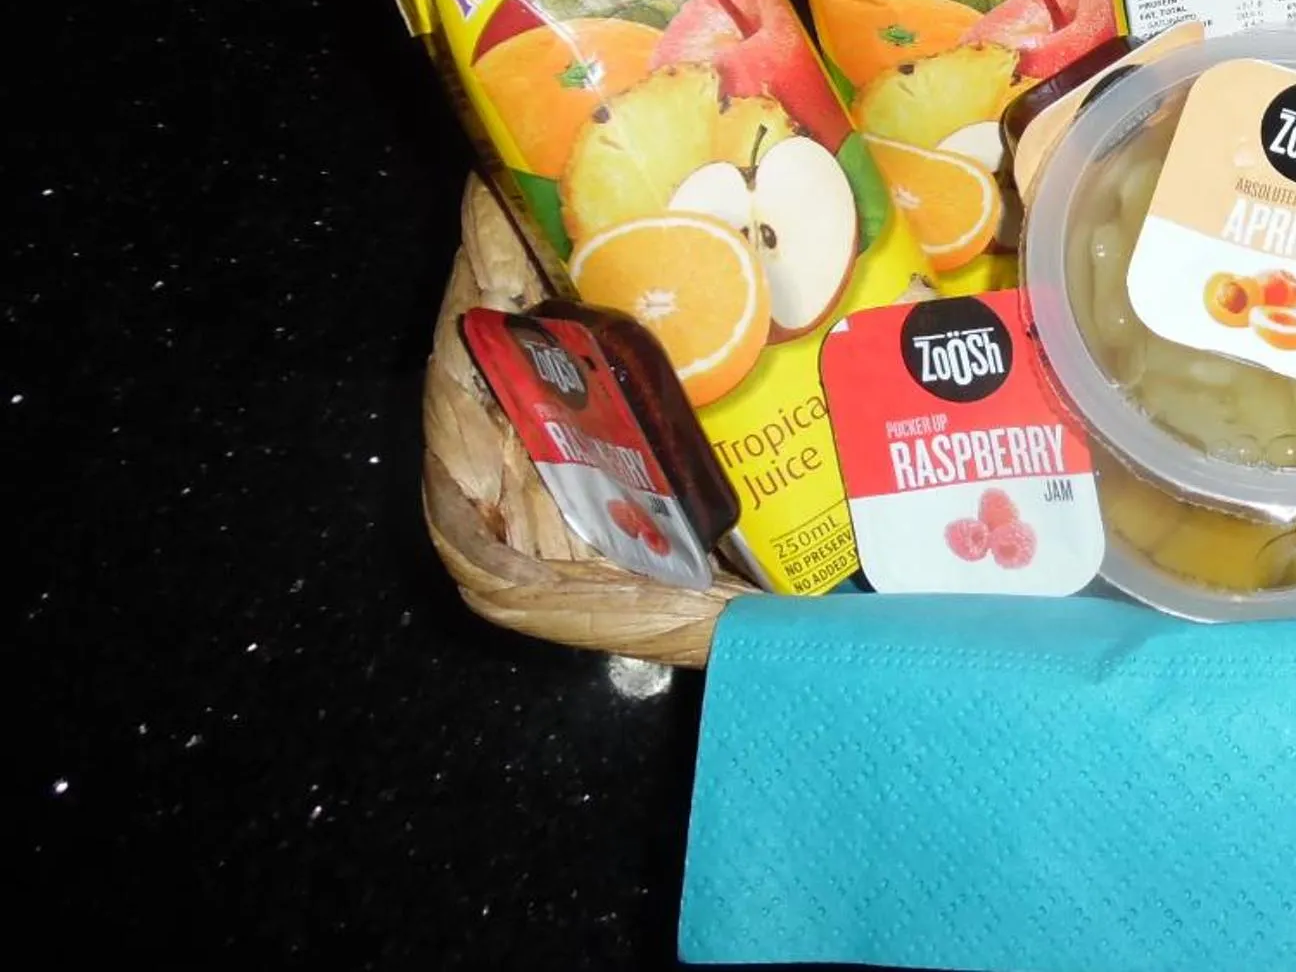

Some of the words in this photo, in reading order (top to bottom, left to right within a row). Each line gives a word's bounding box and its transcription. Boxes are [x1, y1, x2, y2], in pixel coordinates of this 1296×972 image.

[713, 395, 829, 468] Tropica
[889, 424, 1064, 489] RASPBERRY
[743, 445, 822, 510] Juice
[1043, 479, 1074, 502] JAM
[784, 560, 803, 576] NO
[805, 531, 852, 568] PRESERV
[794, 579, 812, 593] NO
[813, 558, 848, 585] ADDED
